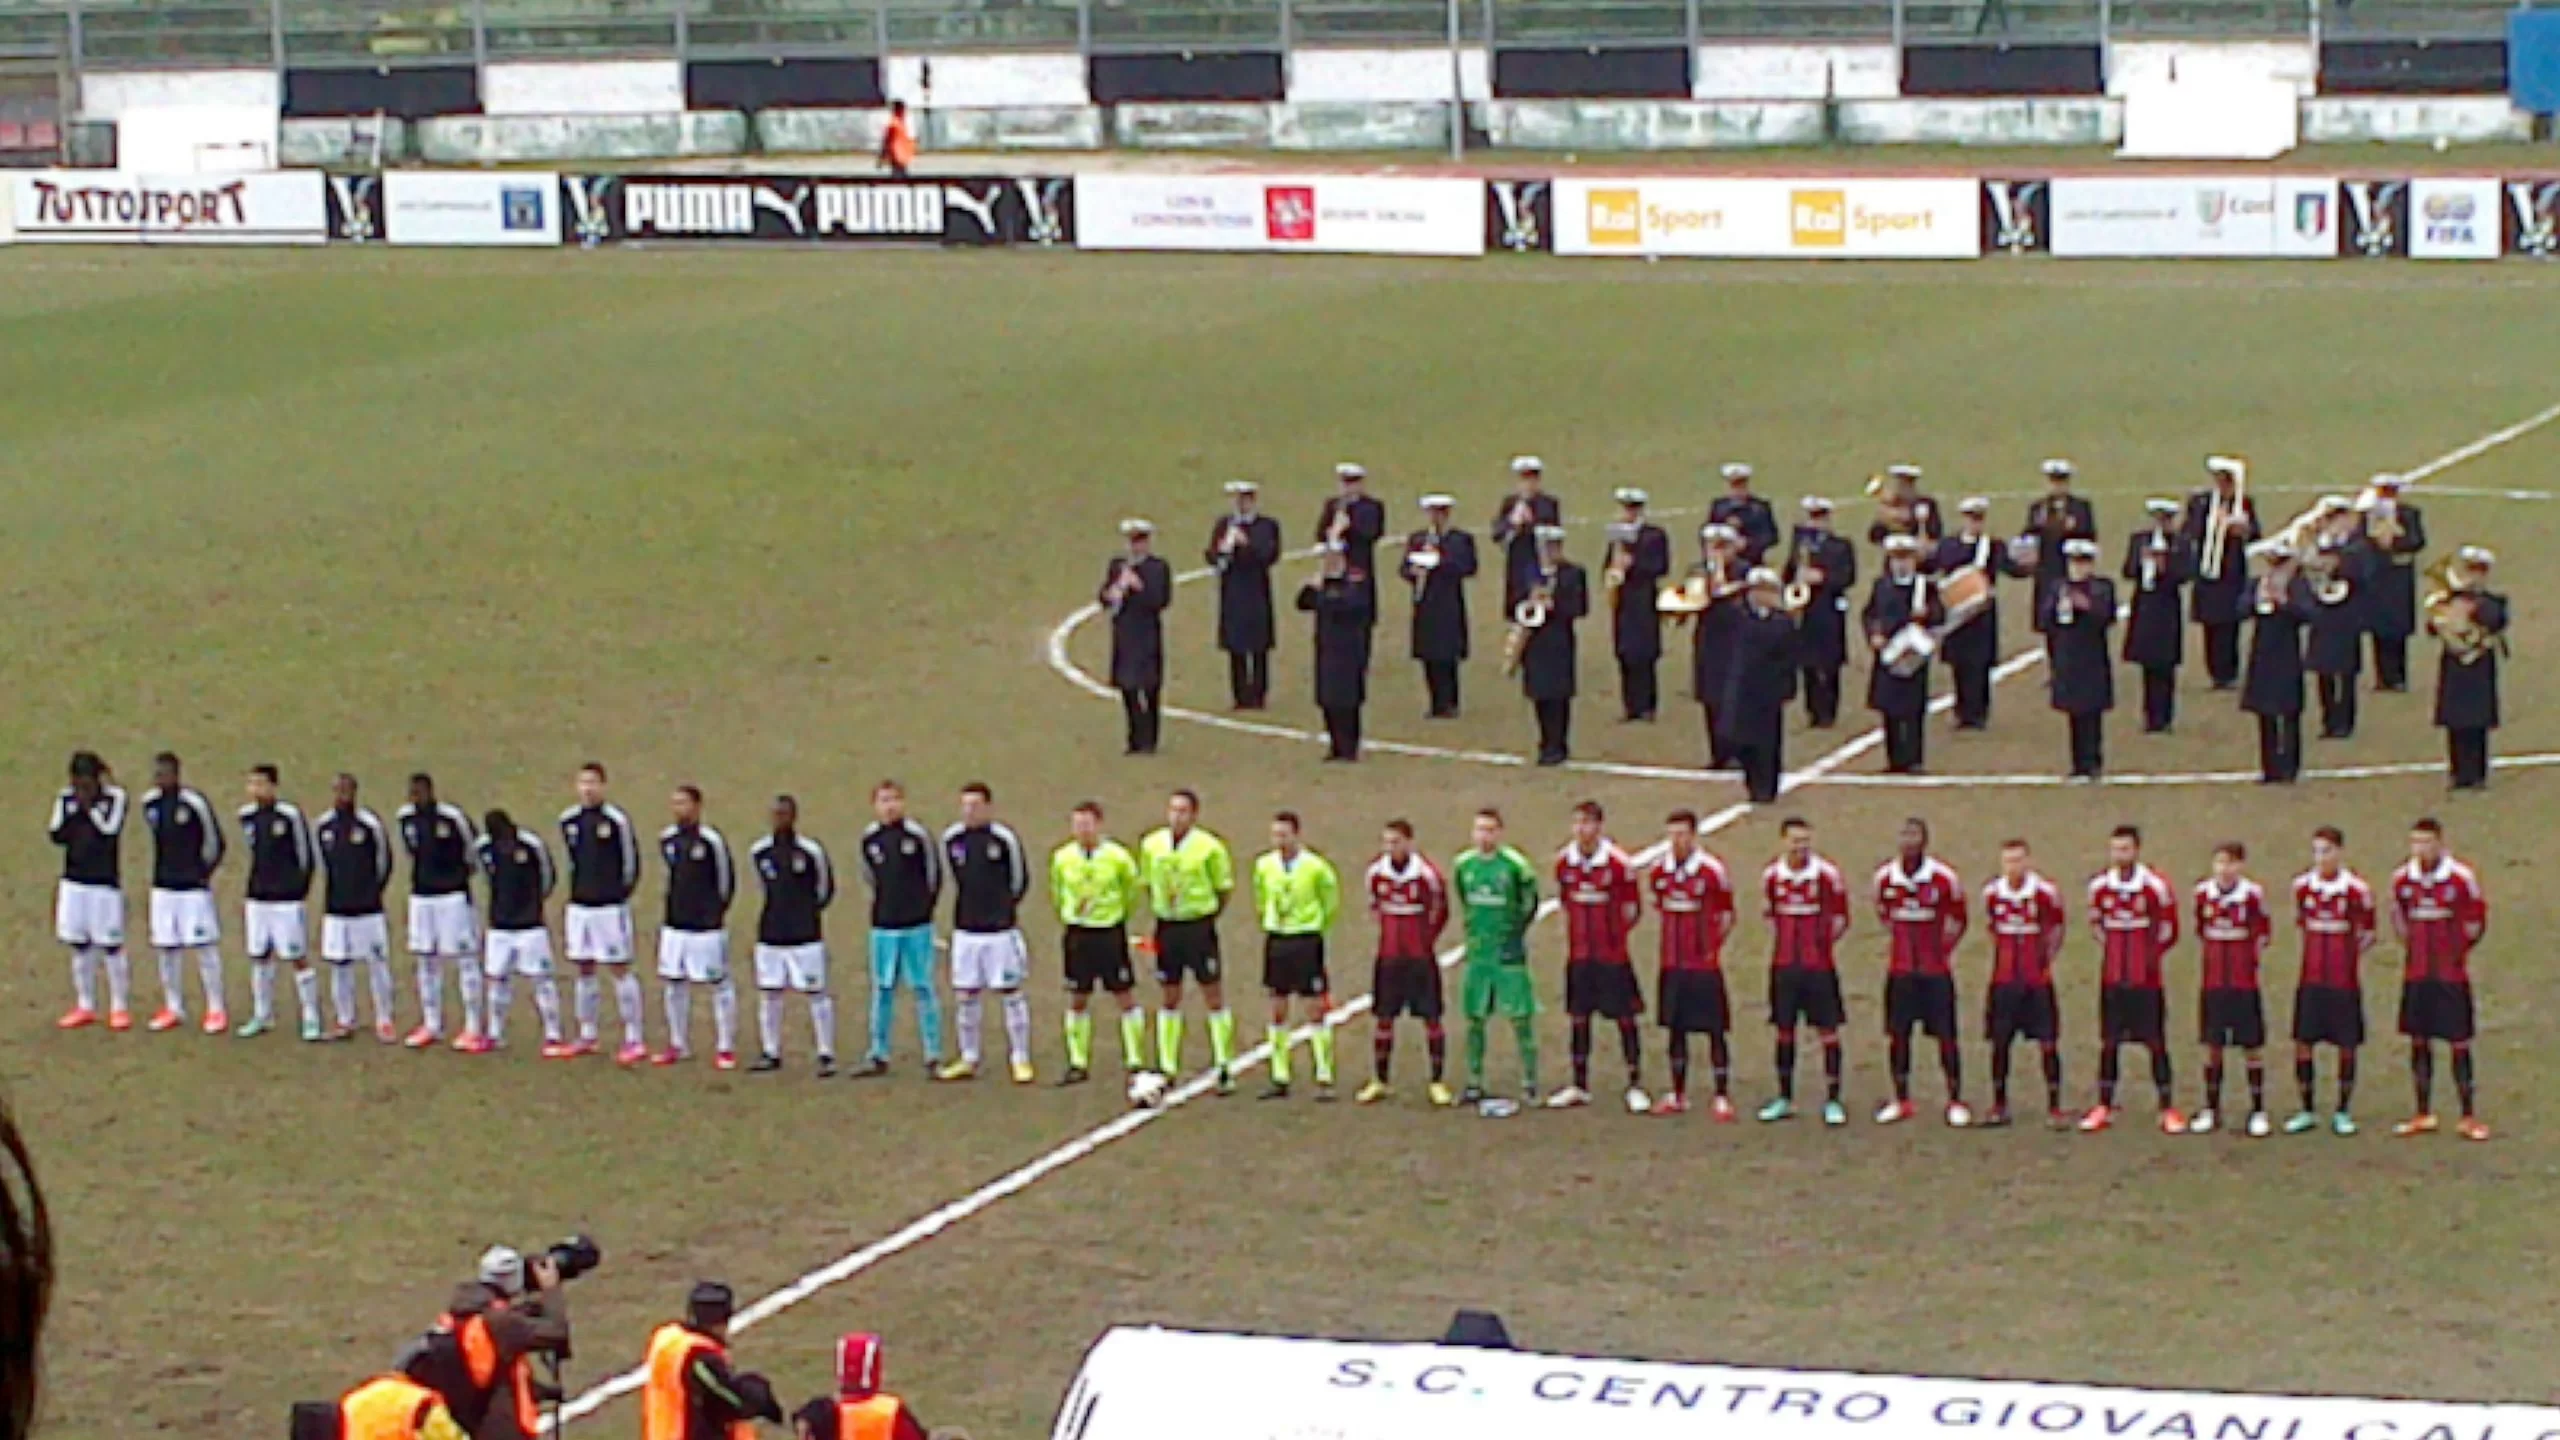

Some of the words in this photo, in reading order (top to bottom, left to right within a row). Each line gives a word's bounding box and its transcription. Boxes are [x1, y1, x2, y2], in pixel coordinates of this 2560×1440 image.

[624, 184, 753, 233] PUMA
[815, 183, 945, 233] PUMA
[1647, 203, 1724, 236] Sport
[1854, 204, 1933, 237] Sport
[2426, 225, 2475, 244] FIFA
[1532, 1371, 1890, 1423] CENTRO
[1932, 1396, 2302, 1440] GIOVANI
